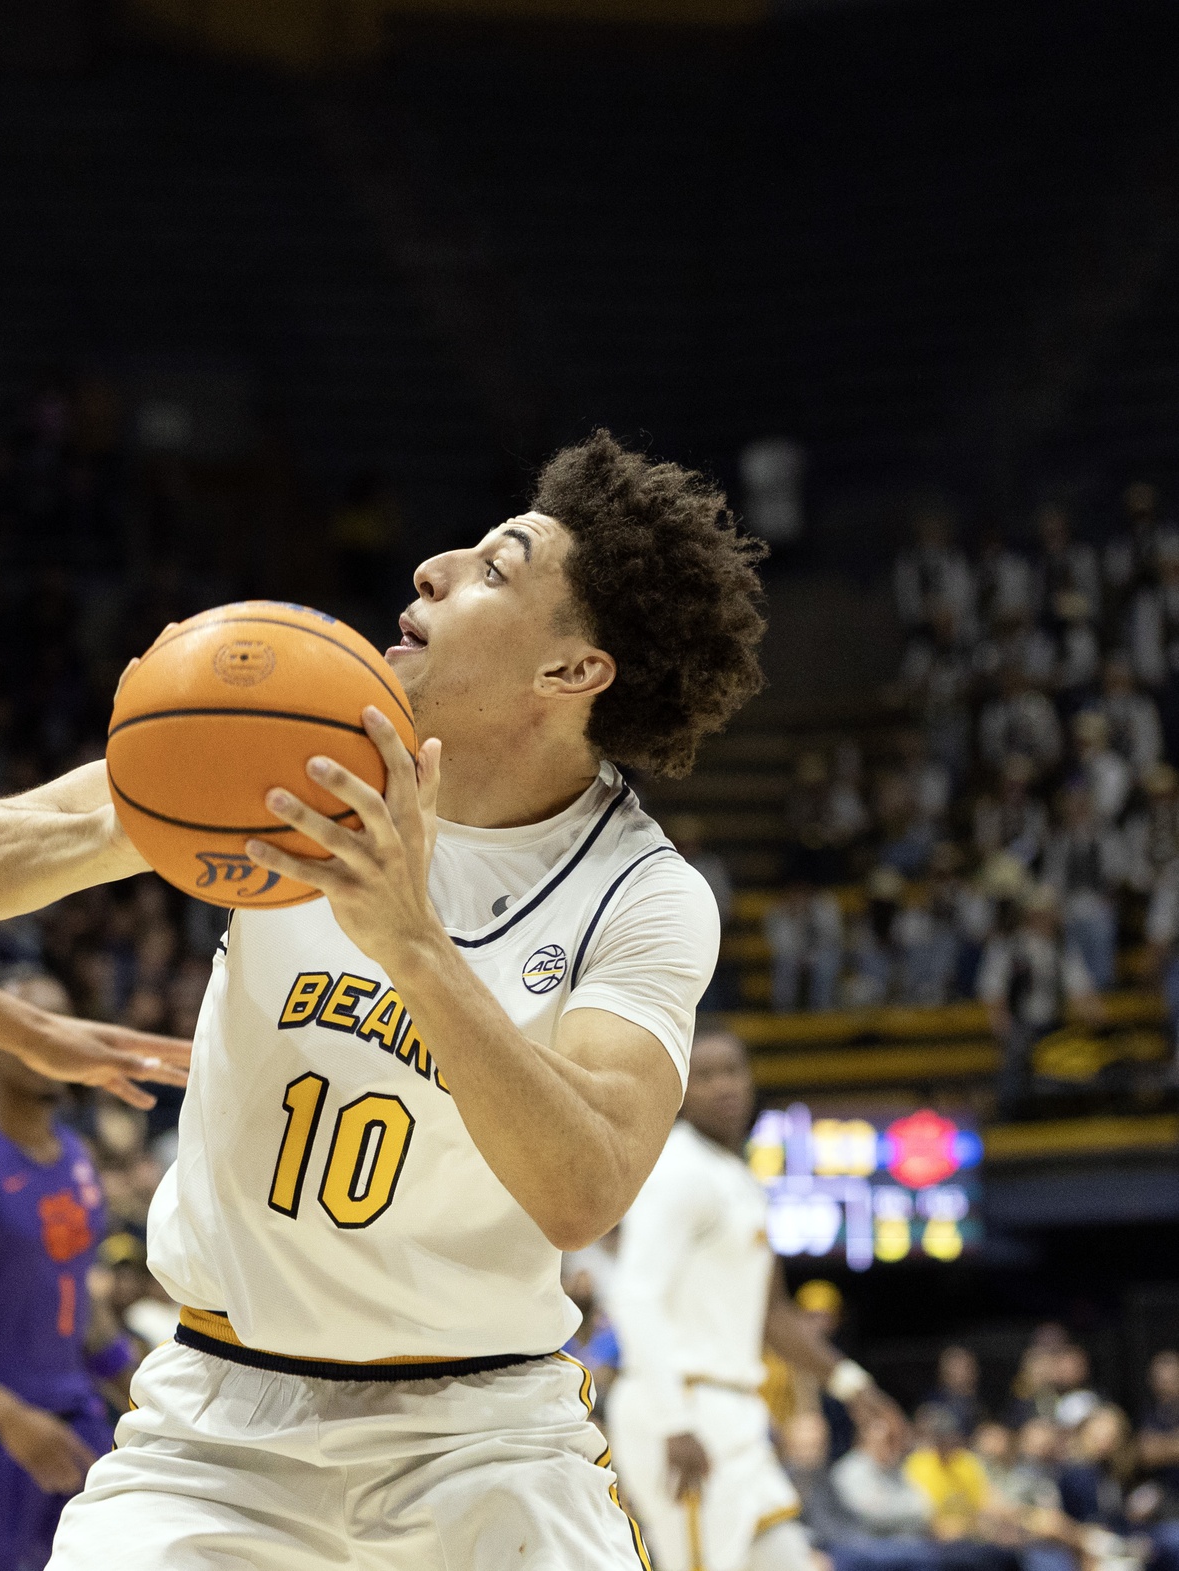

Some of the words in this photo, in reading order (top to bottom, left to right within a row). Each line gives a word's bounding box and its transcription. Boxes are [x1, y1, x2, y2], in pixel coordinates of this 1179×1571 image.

[195, 852, 282, 897] Cal
[527, 957, 566, 973] ACC
[278, 971, 452, 1095] BEAR
[268, 1071, 416, 1229] 10
[58, 1272, 76, 1338] 1
